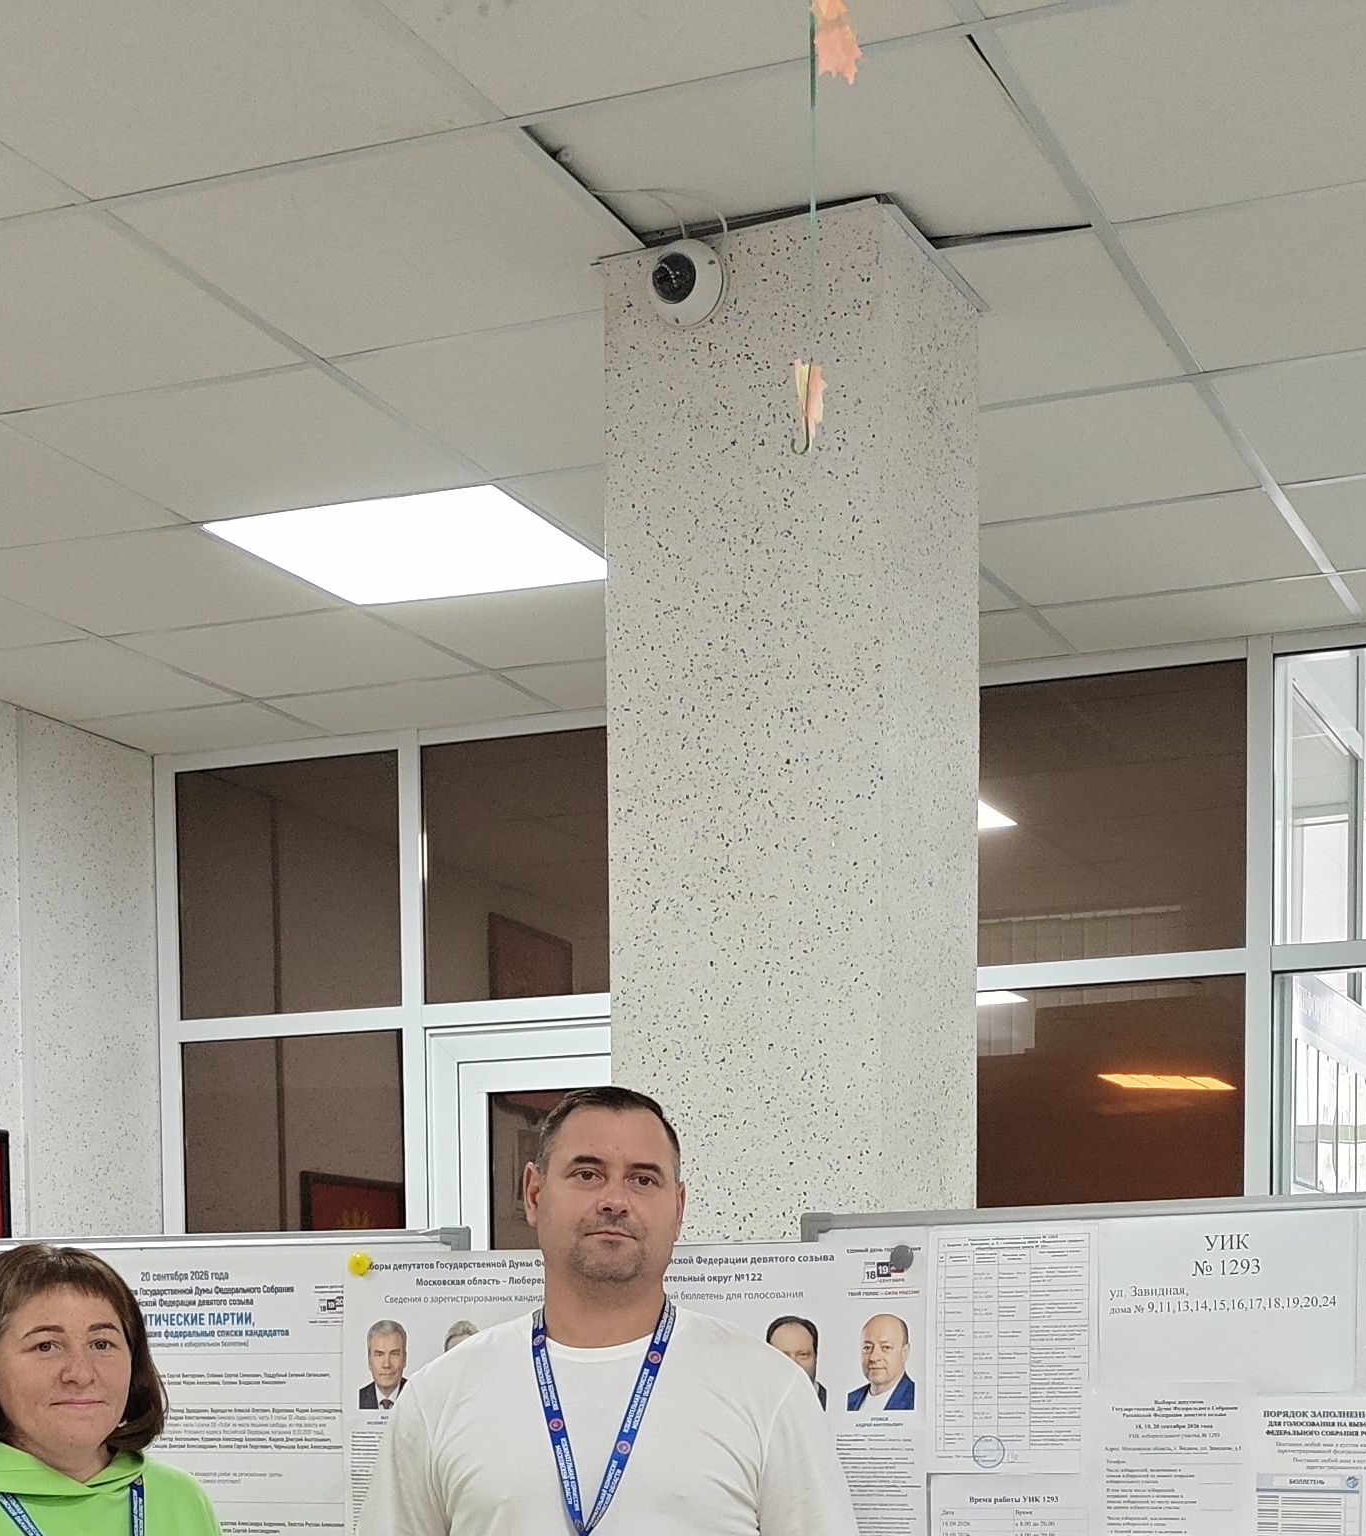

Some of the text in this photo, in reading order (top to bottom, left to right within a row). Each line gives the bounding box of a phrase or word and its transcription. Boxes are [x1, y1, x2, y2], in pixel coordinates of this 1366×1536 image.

[1204, 1233, 1250, 1252] УИК
[370, 1260, 533, 1272] боры депутатов Государственной Думы
[696, 1254, 834, 1266] Федерации девятого созыва
[866, 1264, 888, 1280] 18 19
[1192, 1258, 1261, 1276] № 1293
[141, 1271, 229, 1283] 20 сентября 2026 года
[416, 1278, 465, 1286] Московская
[468, 1278, 501, 1286] область
[707, 1273, 733, 1284] округ
[735, 1273, 762, 1283] №122
[140, 1285, 294, 1297] Государственной Думы Федерального Собрания
[680, 1290, 803, 1301] бюллетень для голосования
[1109, 1286, 1189, 1300] ул. Завидная,
[159, 1299, 196, 1308] Федерации
[229, 1298, 253, 1306] созыва
[385, 1295, 422, 1305] Сведения
[430, 1295, 512, 1305] зарегистрированных
[1109, 1295, 1337, 1315] дома № 9,11,13,14,15,16,17,18,19,20,24
[208, 1312, 255, 1327] ПАРТИИ,
[164, 1330, 214, 1340] федеральные
[245, 1328, 289, 1338] кандидатов
[1263, 1410, 1308, 1419] ПОРЯДОК
[969, 1496, 992, 1504] Время
[994, 1496, 1020, 1504] работы
